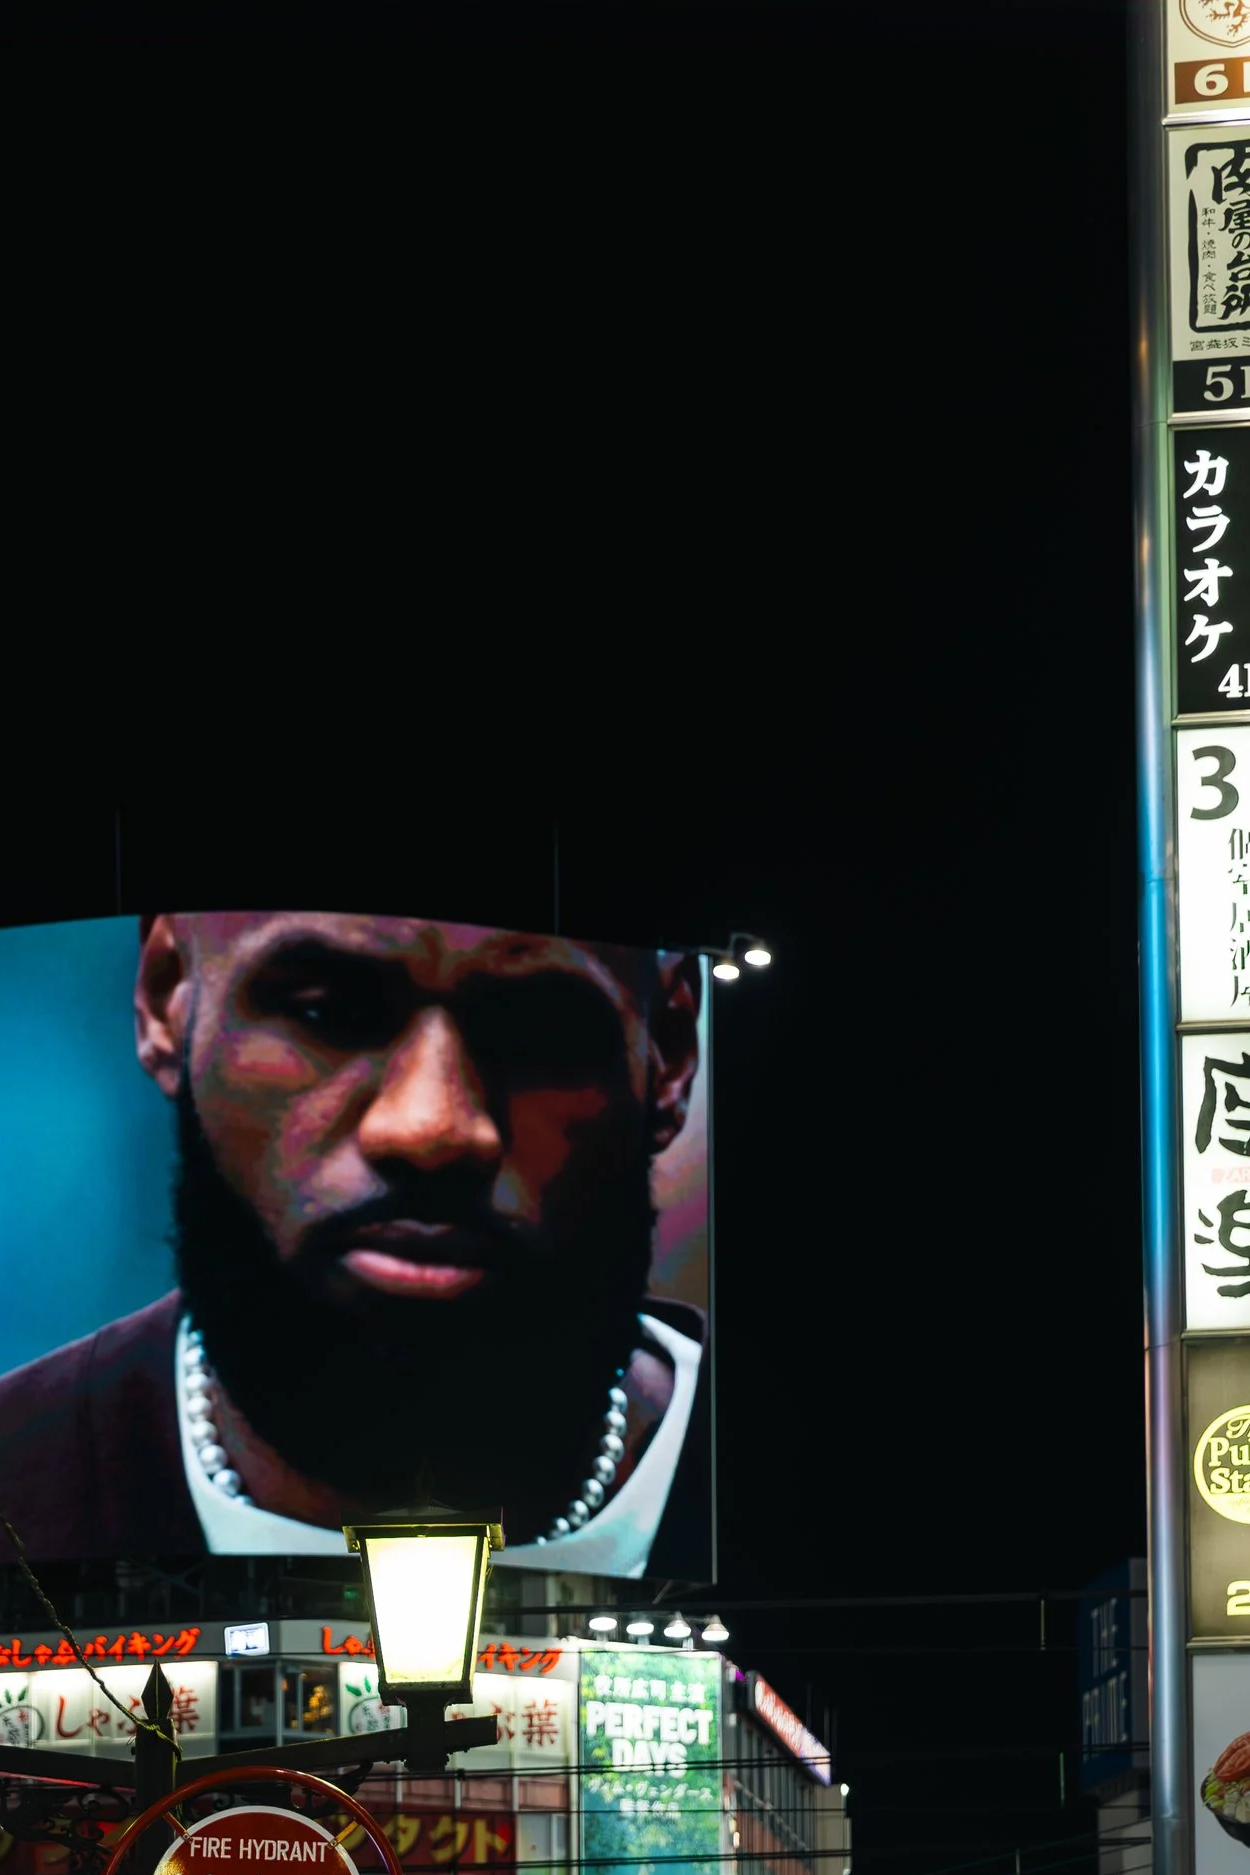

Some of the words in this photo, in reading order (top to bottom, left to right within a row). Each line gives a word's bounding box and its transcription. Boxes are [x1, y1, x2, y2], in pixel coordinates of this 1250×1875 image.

[1193, 61, 1250, 98] 6
[1183, 449, 1234, 664] カラオケ
[1218, 663, 1250, 698] 4
[586, 1701, 714, 1746] PERFECT
[612, 1738, 689, 1779] DAYS
[190, 1836, 232, 1859] FIRE
[239, 1838, 329, 1863] HYDRANT
